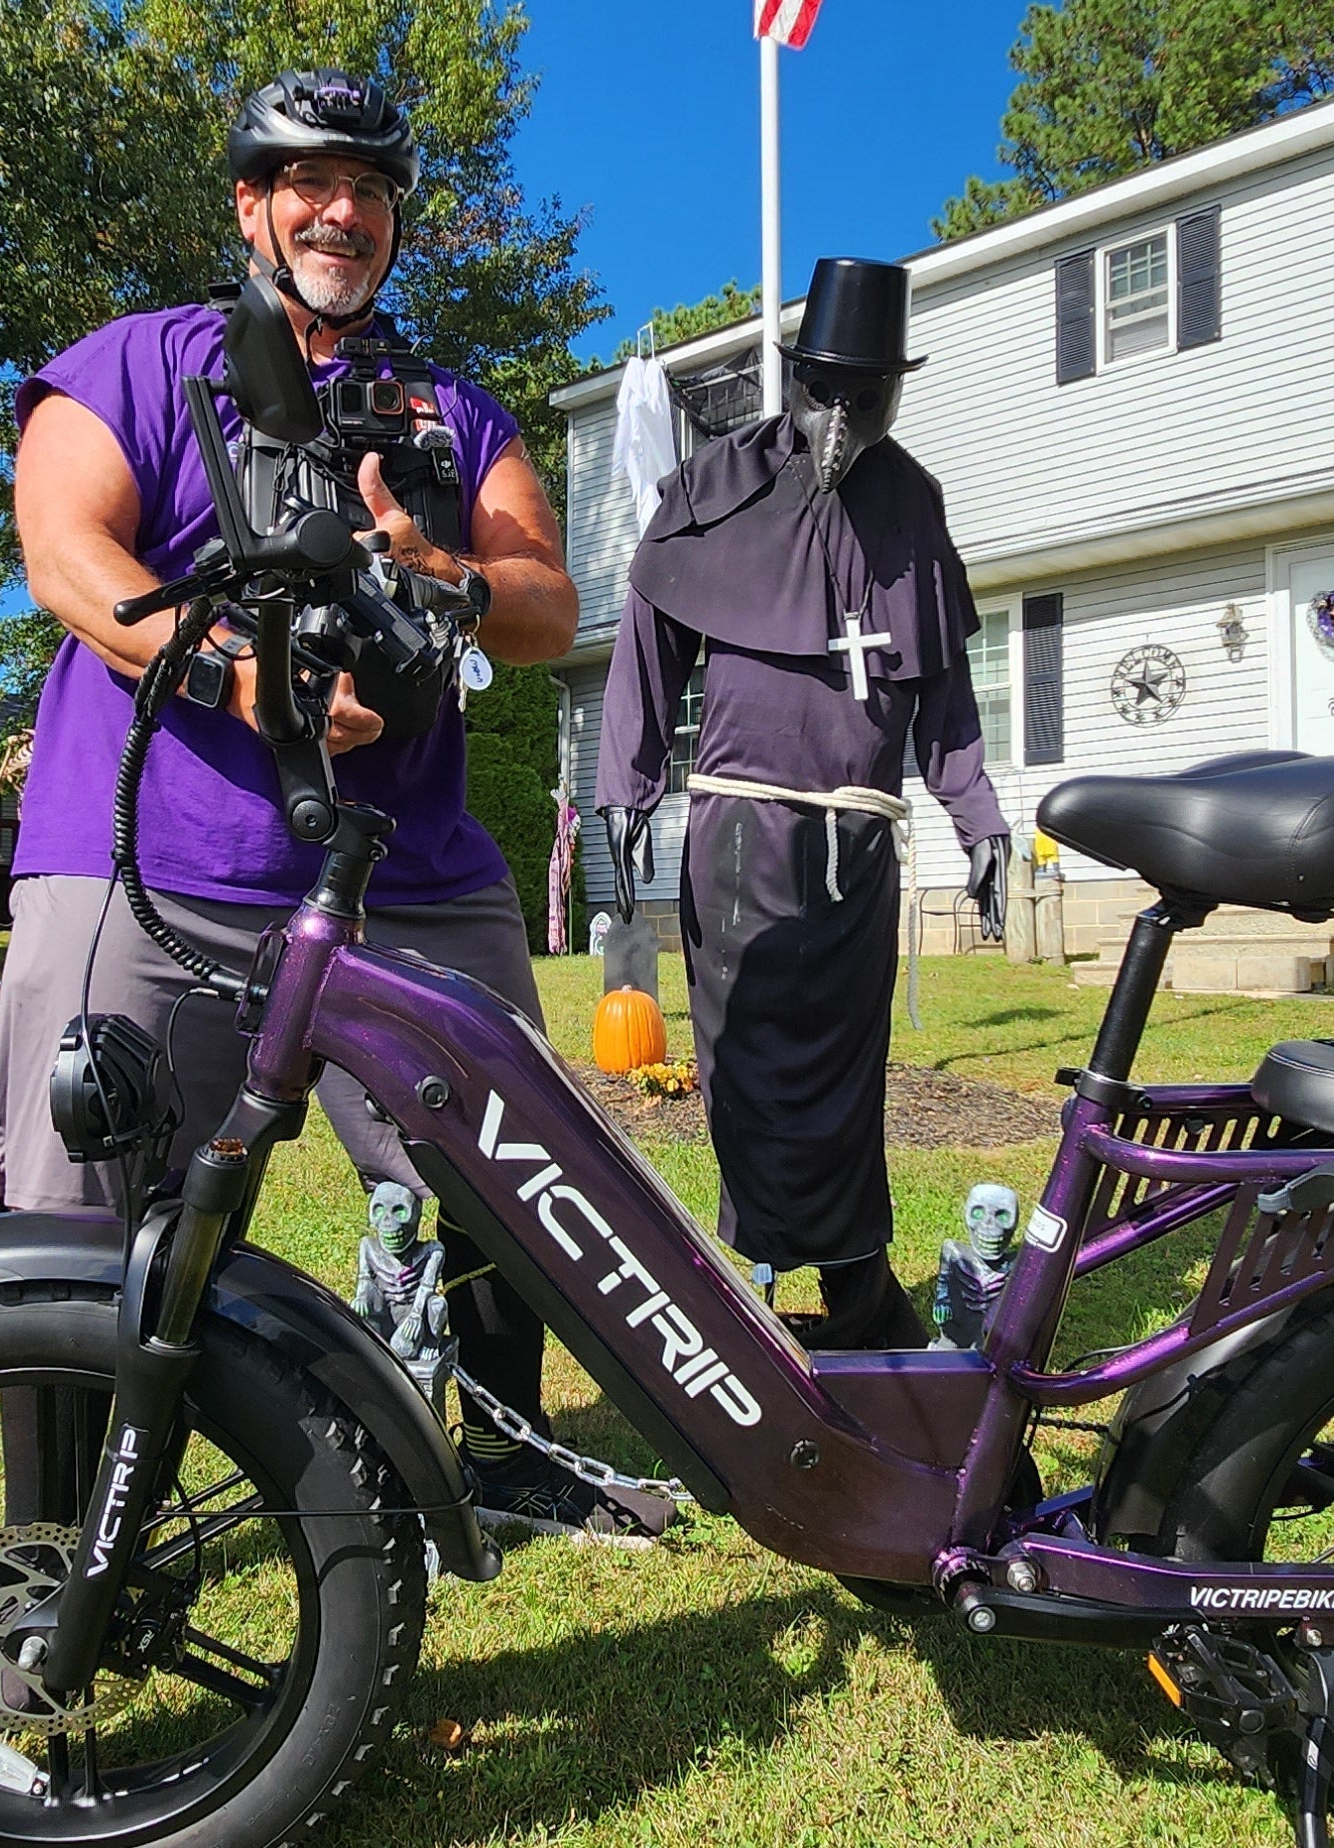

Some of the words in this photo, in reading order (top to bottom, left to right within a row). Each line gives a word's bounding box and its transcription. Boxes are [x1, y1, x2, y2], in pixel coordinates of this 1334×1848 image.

[478, 1088, 763, 1427] VICTRIP
[86, 1428, 139, 1578] VICTRIP
[136, 1628, 156, 1654] RSX
